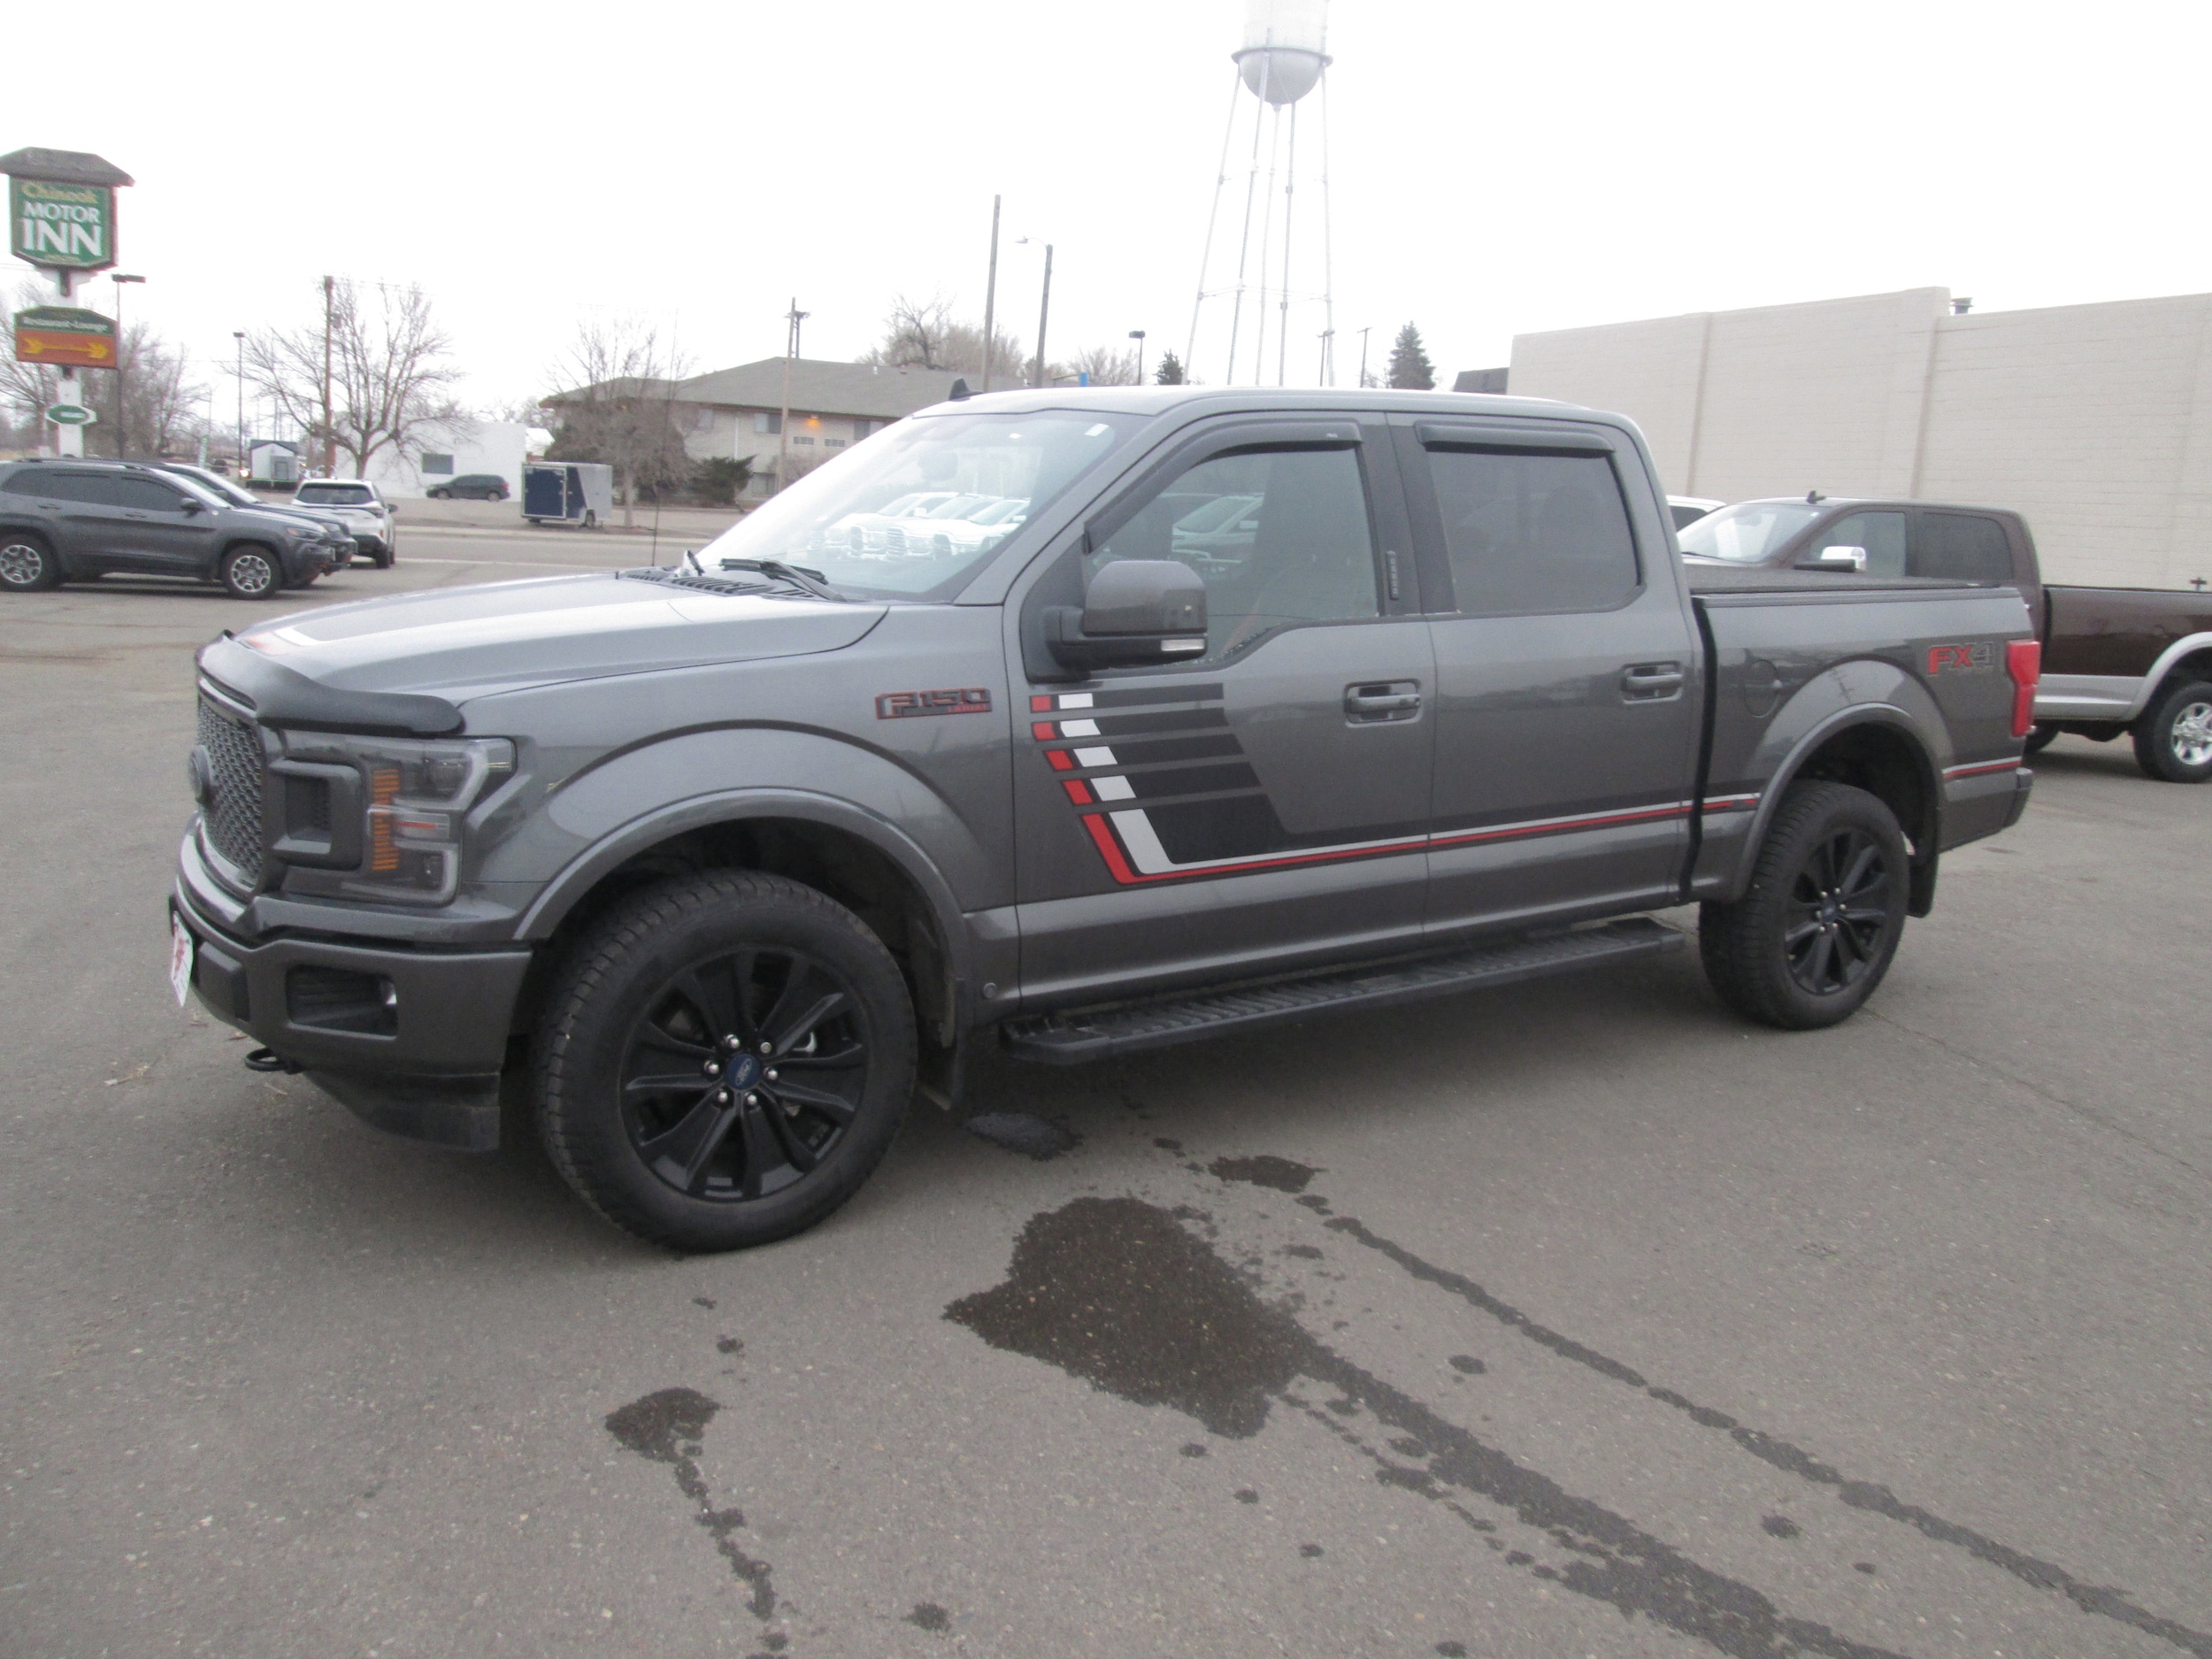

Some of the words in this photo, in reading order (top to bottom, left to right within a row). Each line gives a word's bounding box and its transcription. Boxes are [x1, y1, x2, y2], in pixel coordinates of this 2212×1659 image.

[23, 200, 101, 224] MOTOR
[21, 218, 103, 257] INN
[1927, 641, 1994, 676] FX4
